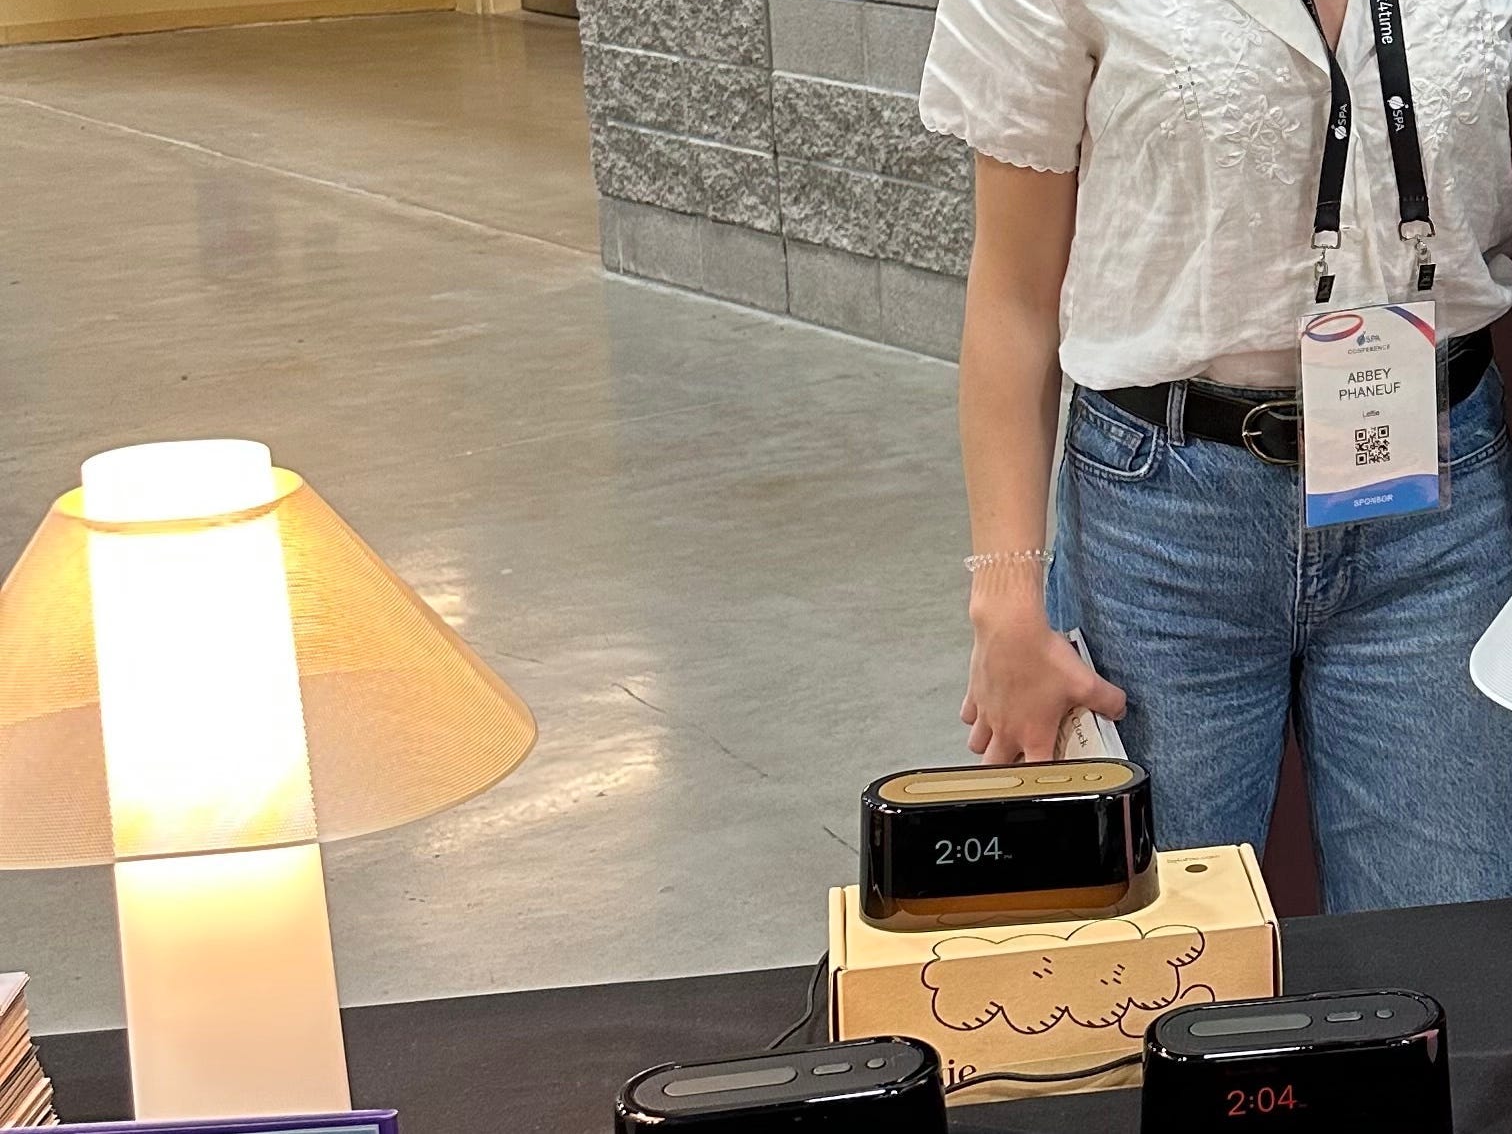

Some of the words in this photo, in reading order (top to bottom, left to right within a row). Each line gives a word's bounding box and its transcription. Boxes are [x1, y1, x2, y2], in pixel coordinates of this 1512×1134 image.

[1347, 344, 1391, 355] CONFERENCE
[1347, 368, 1392, 385] ABBEY
[1339, 381, 1402, 401] PHANEUF
[1353, 494, 1394, 508] SPONSOR
[935, 836, 1003, 865] 2:04
[1226, 1084, 1297, 1116] 2:04
